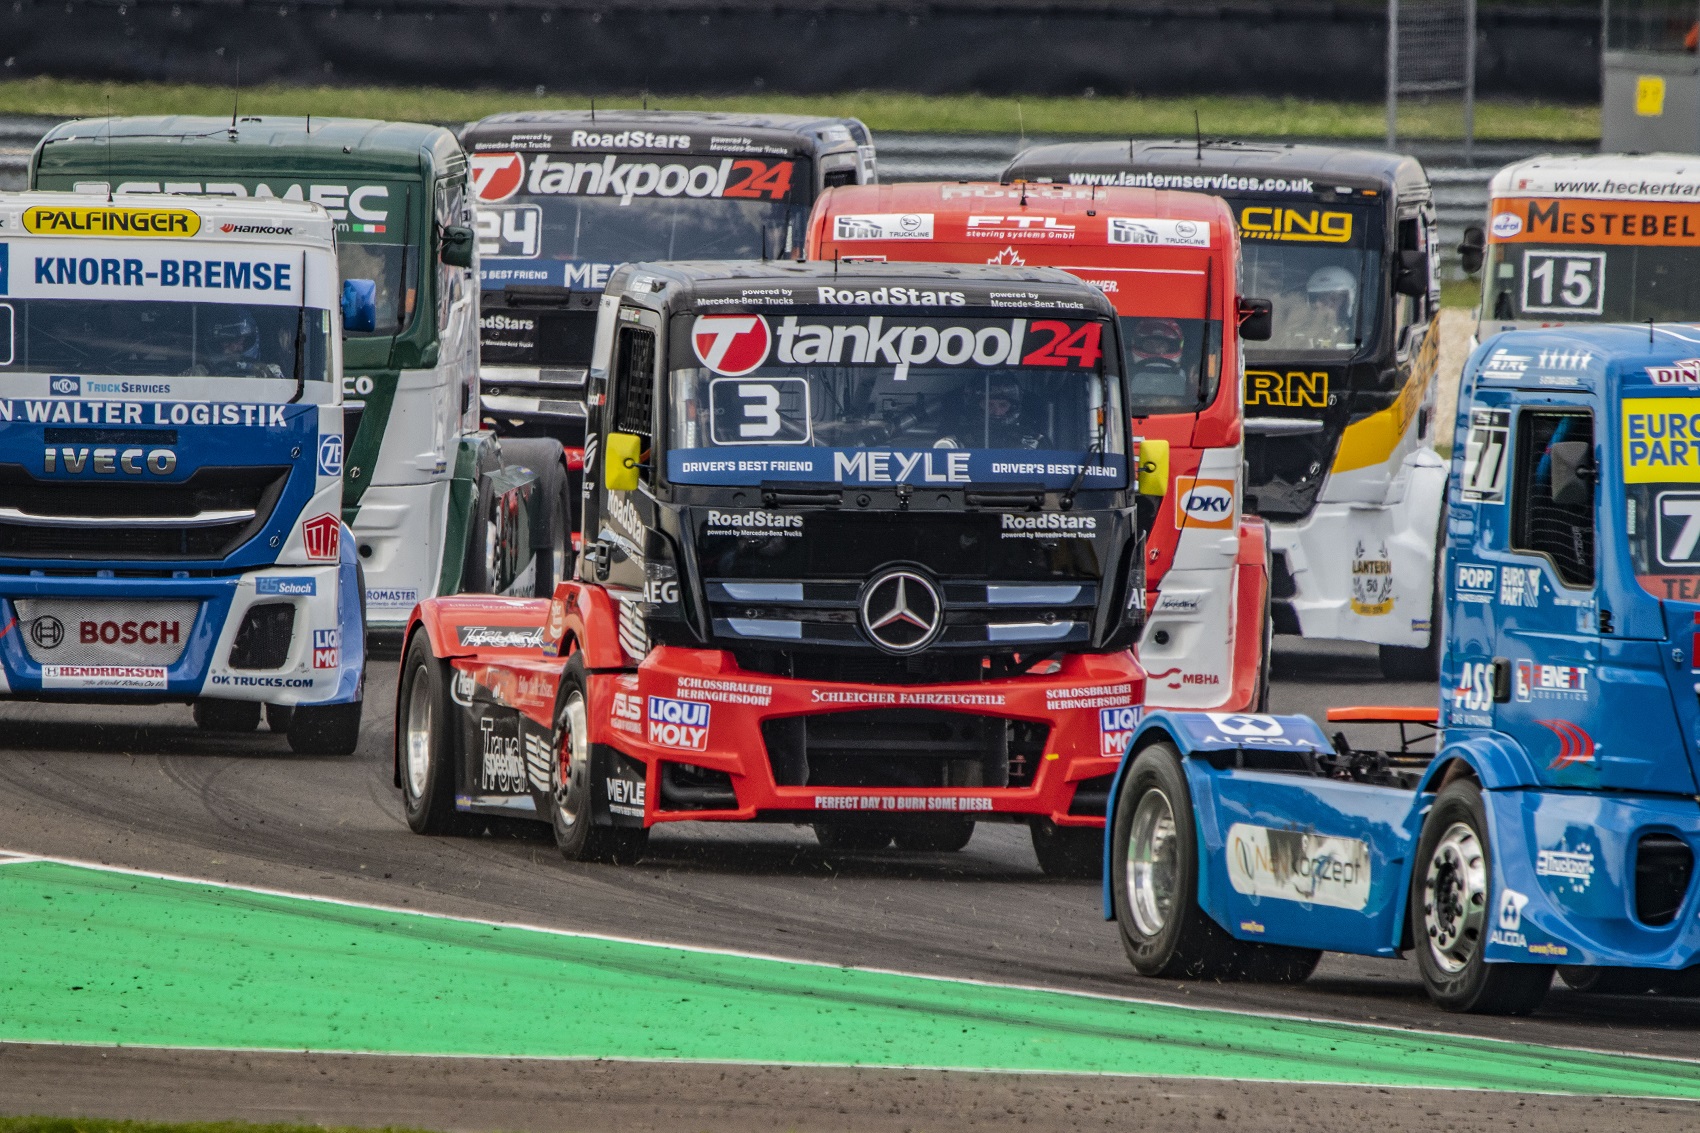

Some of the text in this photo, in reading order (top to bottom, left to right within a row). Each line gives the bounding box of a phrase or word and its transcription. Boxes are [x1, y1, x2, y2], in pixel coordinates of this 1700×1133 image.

[572, 131, 691, 149] RoadStars
[1069, 172, 1314, 194] www.lanternservices.co.uk
[35, 210, 188, 233] PALFINGER
[967, 216, 1076, 229] FTL
[966, 231, 1005, 239] steering
[1007, 232, 1046, 240] systems
[1165, 237, 1206, 245] TRUCKLINE
[35, 257, 291, 291] KNORR-BREMSE
[489, 270, 512, 279] BEST
[514, 270, 548, 279] FRIEND
[1532, 259, 1592, 306] 15
[742, 288, 793, 297] powered by
[817, 286, 966, 306] RoadStars
[1028, 292, 1039, 300] by
[697, 297, 794, 306] Mercedes-Benz Trucks
[990, 299, 1084, 310] Mercedes-Benz Trucks
[25, 401, 142, 424] WALTER
[154, 403, 287, 427] LOGISTIK
[738, 384, 781, 437] 3
[45, 448, 177, 475] IVECO
[682, 461, 813, 472] DRIVER'S BEST FRIEND
[833, 451, 971, 483] MEYLE
[992, 463, 1045, 474] DRIVER'S
[1047, 464, 1077, 475] BEST
[1186, 496, 1231, 513] DKV
[708, 510, 803, 527] RoadStars
[1002, 513, 1096, 529] RoadStars
[1352, 560, 1391, 574] LANTERN
[1459, 567, 1493, 589] POPP
[1502, 566, 1525, 586] EURO
[279, 582, 312, 594] Schoch
[643, 581, 679, 604] AEG
[1366, 579, 1378, 592] 50
[1501, 586, 1524, 606] PART
[80, 621, 180, 644] BOSCH
[60, 667, 164, 679] HENDRICKSON
[1182, 674, 1219, 685] MBHA
[212, 675, 313, 689] OK TRUCKS.COM
[677, 677, 772, 695] SCHLOSSBRAUEREI
[1455, 662, 1495, 711] ASS
[677, 688, 771, 706] HERRNGIERSDORF
[811, 689, 1005, 705] SCHLEICHER FAHRZEUGTEILE
[1046, 684, 1131, 699] SCHLOSSBRAUEREI
[1047, 695, 1132, 710] HERRNGIERSDORF
[650, 698, 706, 725] LIQUI
[650, 722, 706, 748] MOLY
[1203, 735, 1322, 748] ALCOA
[606, 777, 646, 805] MEYLE
[815, 796, 993, 811] PERFECT DAY TO BURN SOME DIESEL
[1490, 930, 1527, 947] ALCOA
